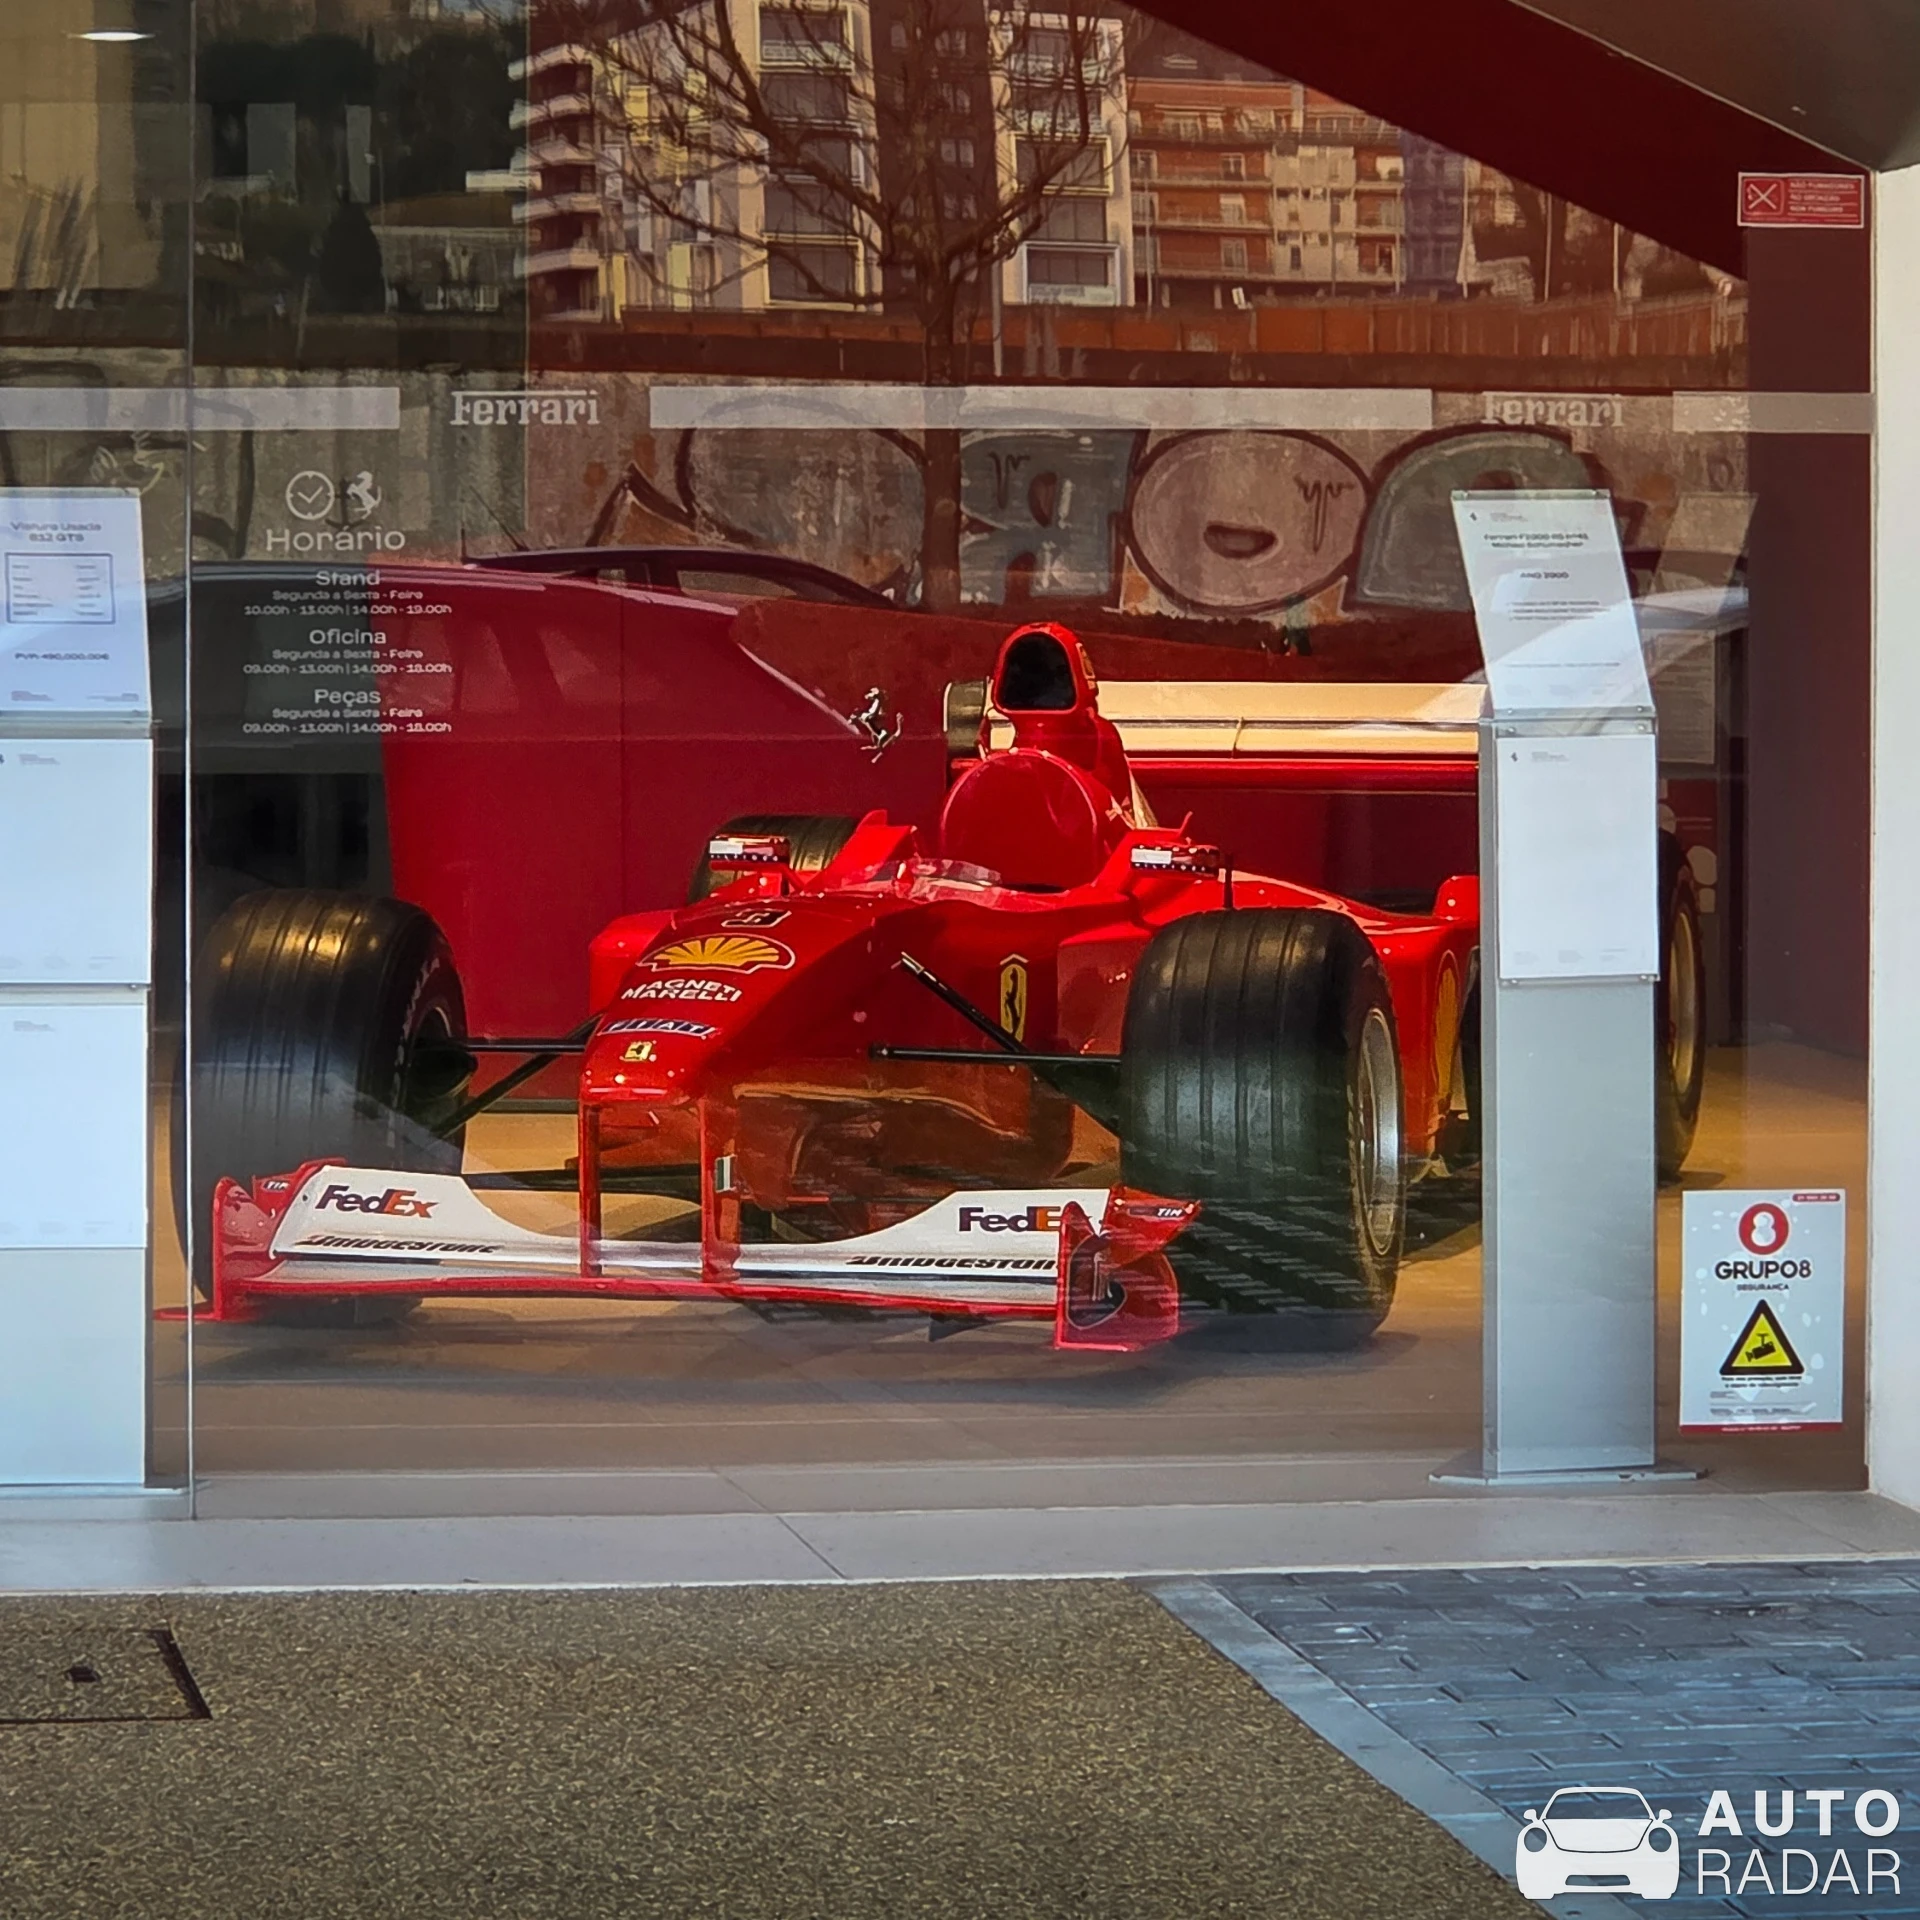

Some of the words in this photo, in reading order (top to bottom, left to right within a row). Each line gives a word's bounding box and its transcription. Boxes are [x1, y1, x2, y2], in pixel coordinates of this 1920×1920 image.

[450, 390, 600, 425] Ferrari
[1481, 391, 1625, 427] Ferrari
[266, 526, 406, 551] Horário
[315, 570, 380, 586] Stand
[272, 590, 330, 601] Segunda
[309, 629, 387, 645] Oficina
[272, 650, 330, 661] Segunda
[314, 689, 381, 707] Peças
[272, 708, 330, 719] Segunda
[621, 984, 742, 1001] MARELLI
[607, 1020, 705, 1033] FIAT
[315, 1184, 439, 1219] FedEx
[959, 1206, 1103, 1232] FedE
[847, 1256, 1058, 1270] BRIDGESTON
[1715, 1259, 1813, 1280] GRUPO8
